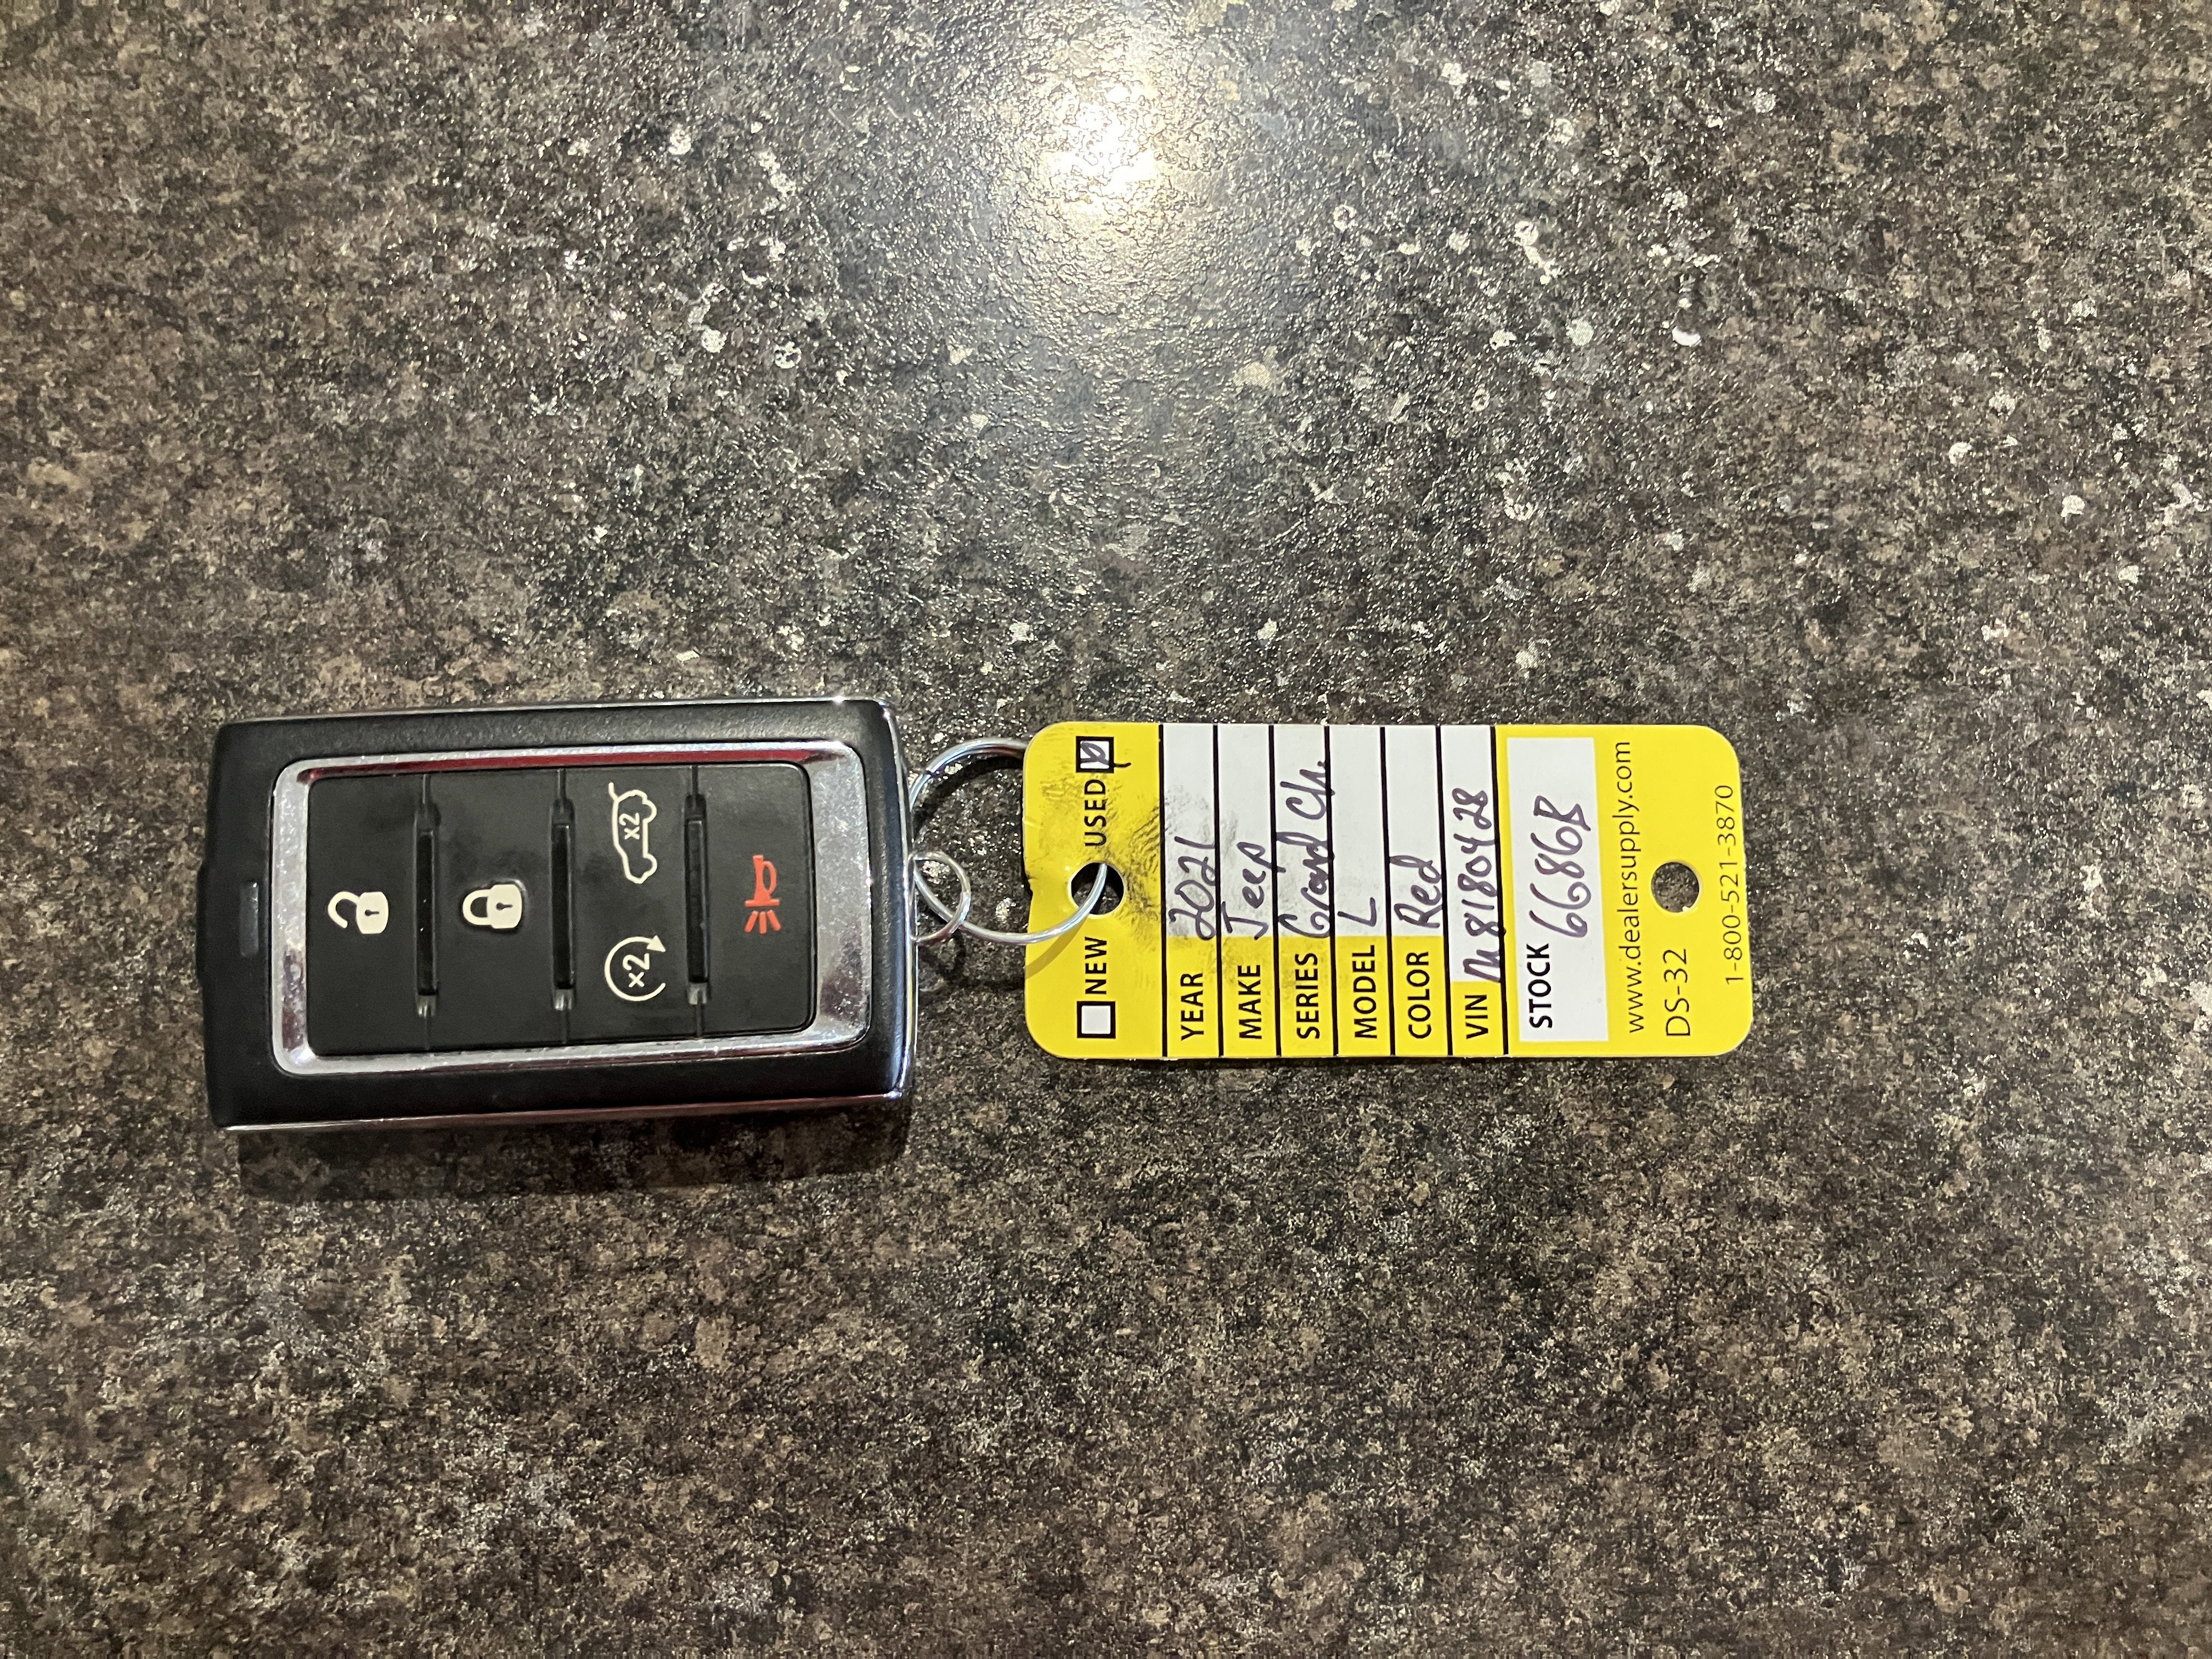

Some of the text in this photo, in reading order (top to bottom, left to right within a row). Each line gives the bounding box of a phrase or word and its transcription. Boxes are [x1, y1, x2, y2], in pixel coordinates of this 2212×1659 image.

[1084, 779, 1106, 847] USED
[1169, 837, 1216, 940] 2021
[1221, 842, 1285, 940] Jeep
[1276, 832, 1334, 939] Grand
[1390, 856, 1442, 928] Red
[1530, 795, 1591, 938] 6686B
[1612, 742, 1645, 1033] www.dealersupply.com
[1715, 785, 1745, 985] 1-800-521-3870
[1338, 898, 1376, 927] L
[1085, 937, 1107, 995] NEW
[1181, 973, 1204, 1040] YEAR
[1239, 964, 1261, 1040] MAKE
[1296, 952, 1319, 1039] SERIES
[1353, 945, 1377, 1039] MODEL
[1407, 951, 1431, 1039] COLOR
[1527, 943, 1552, 1028] STOCK
[1663, 949, 1690, 1036] DS-32
[1465, 994, 1489, 1039] VIN
